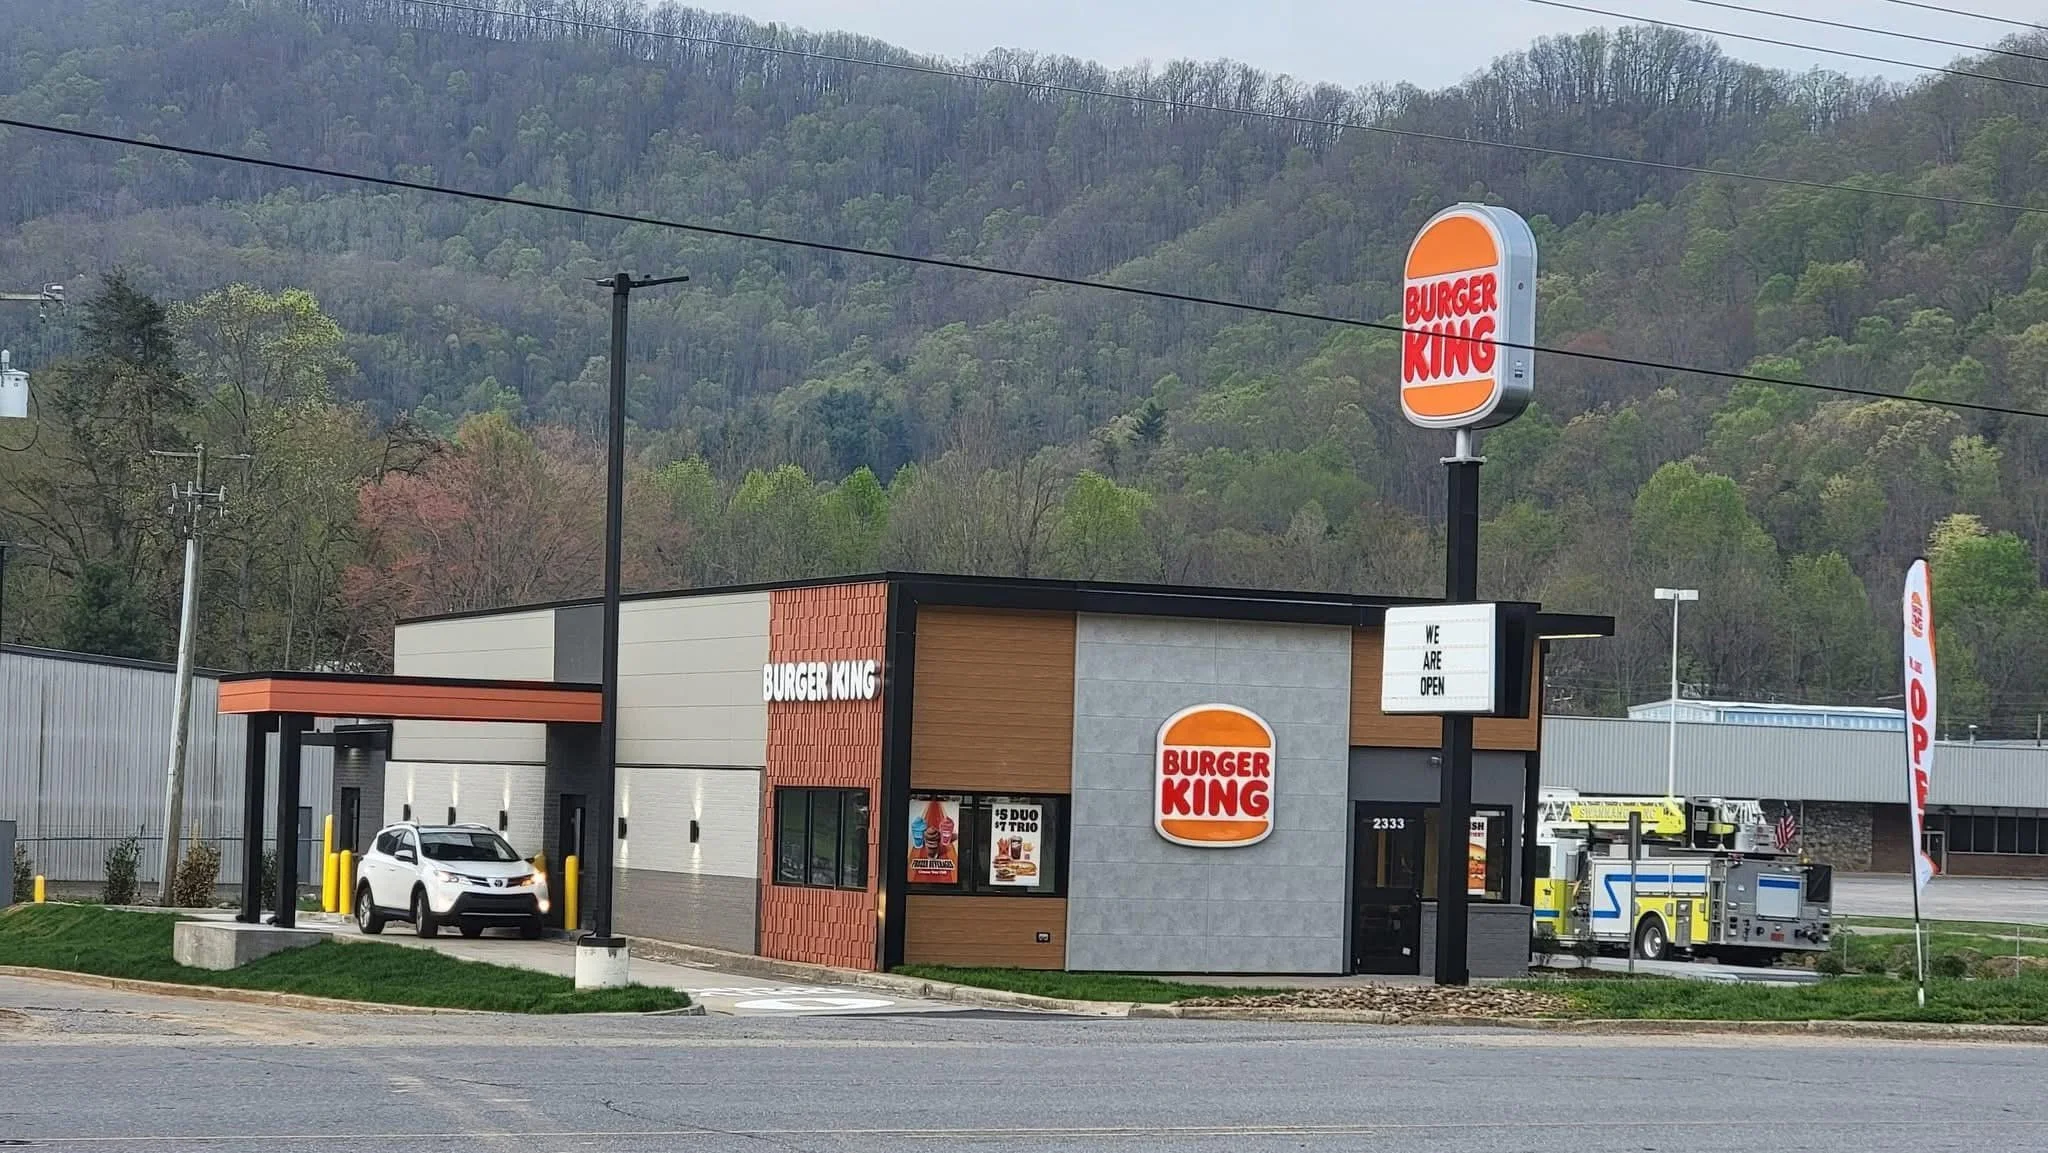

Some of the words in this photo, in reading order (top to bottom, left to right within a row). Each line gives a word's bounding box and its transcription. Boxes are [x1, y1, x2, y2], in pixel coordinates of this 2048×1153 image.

[1406, 273, 1497, 324] BURGER
[1404, 316, 1496, 383] KING
[1426, 624, 1440, 644] WE
[1423, 650, 1442, 670] ARE
[763, 663, 828, 701] BURGER
[831, 660, 876, 700] KING
[1420, 676, 1445, 696] OPEN
[1163, 750, 1270, 777] BURGER
[1910, 678, 1929, 834] OPE
[1162, 778, 1270, 817] KING
[995, 808, 1008, 820] $5
[1010, 808, 1039, 821] DUO
[1373, 818, 1405, 829] 2333
[995, 821, 1007, 832] $7
[1009, 822, 1038, 833] TRIO
